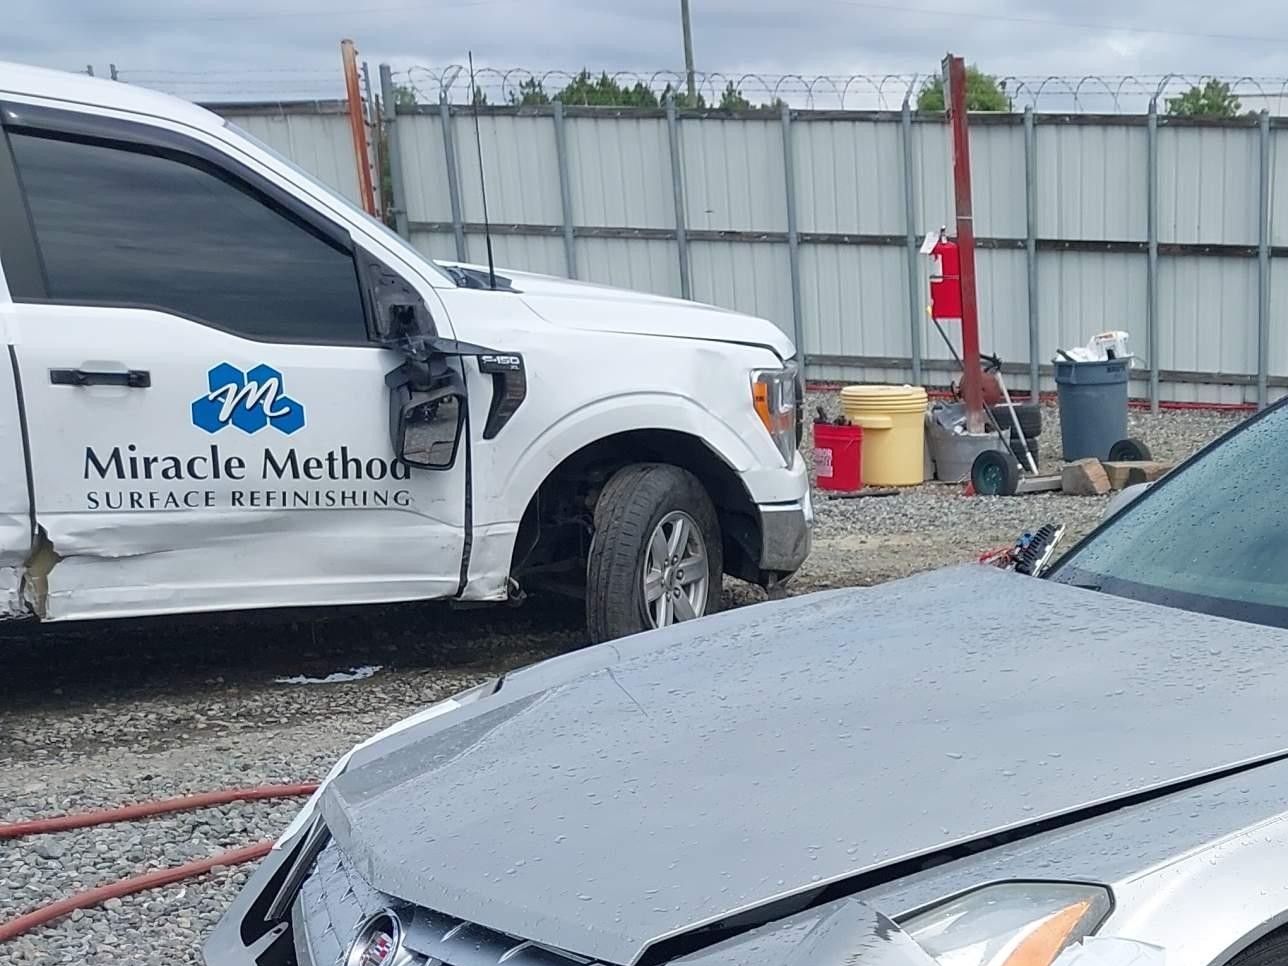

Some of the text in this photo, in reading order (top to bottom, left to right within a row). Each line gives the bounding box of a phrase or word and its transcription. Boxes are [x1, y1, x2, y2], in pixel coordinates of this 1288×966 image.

[482, 355, 520, 365] F-150
[84, 444, 246, 480] Miracle
[87, 489, 410, 510] SURFACE REFINISHING
